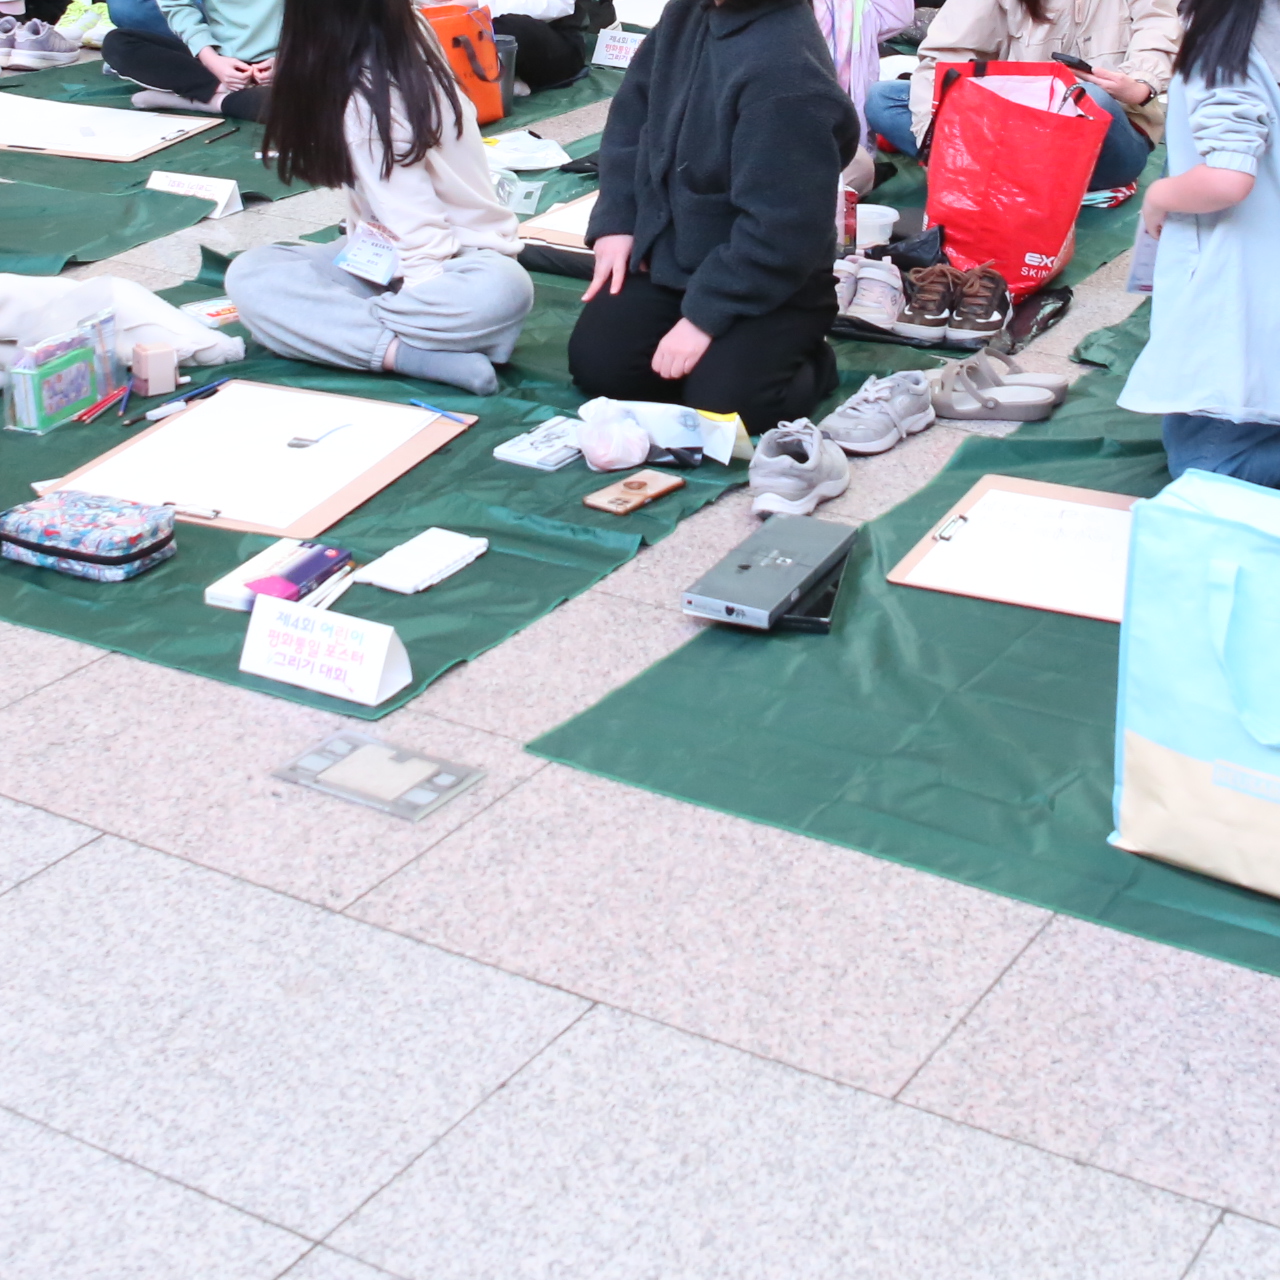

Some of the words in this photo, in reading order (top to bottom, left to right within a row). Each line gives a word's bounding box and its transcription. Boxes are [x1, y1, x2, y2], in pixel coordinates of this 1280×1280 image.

[605, 43, 631, 55] 평화통일
[609, 35, 629, 44] 제4회
[608, 53, 629, 62] 그리기
[276, 611, 316, 633] 제4회
[320, 621, 365, 646] 어린이
[268, 629, 320, 659] 평화통일
[324, 644, 365, 666] 포스터
[273, 651, 315, 675] 그리기
[319, 664, 348, 683] 대회
